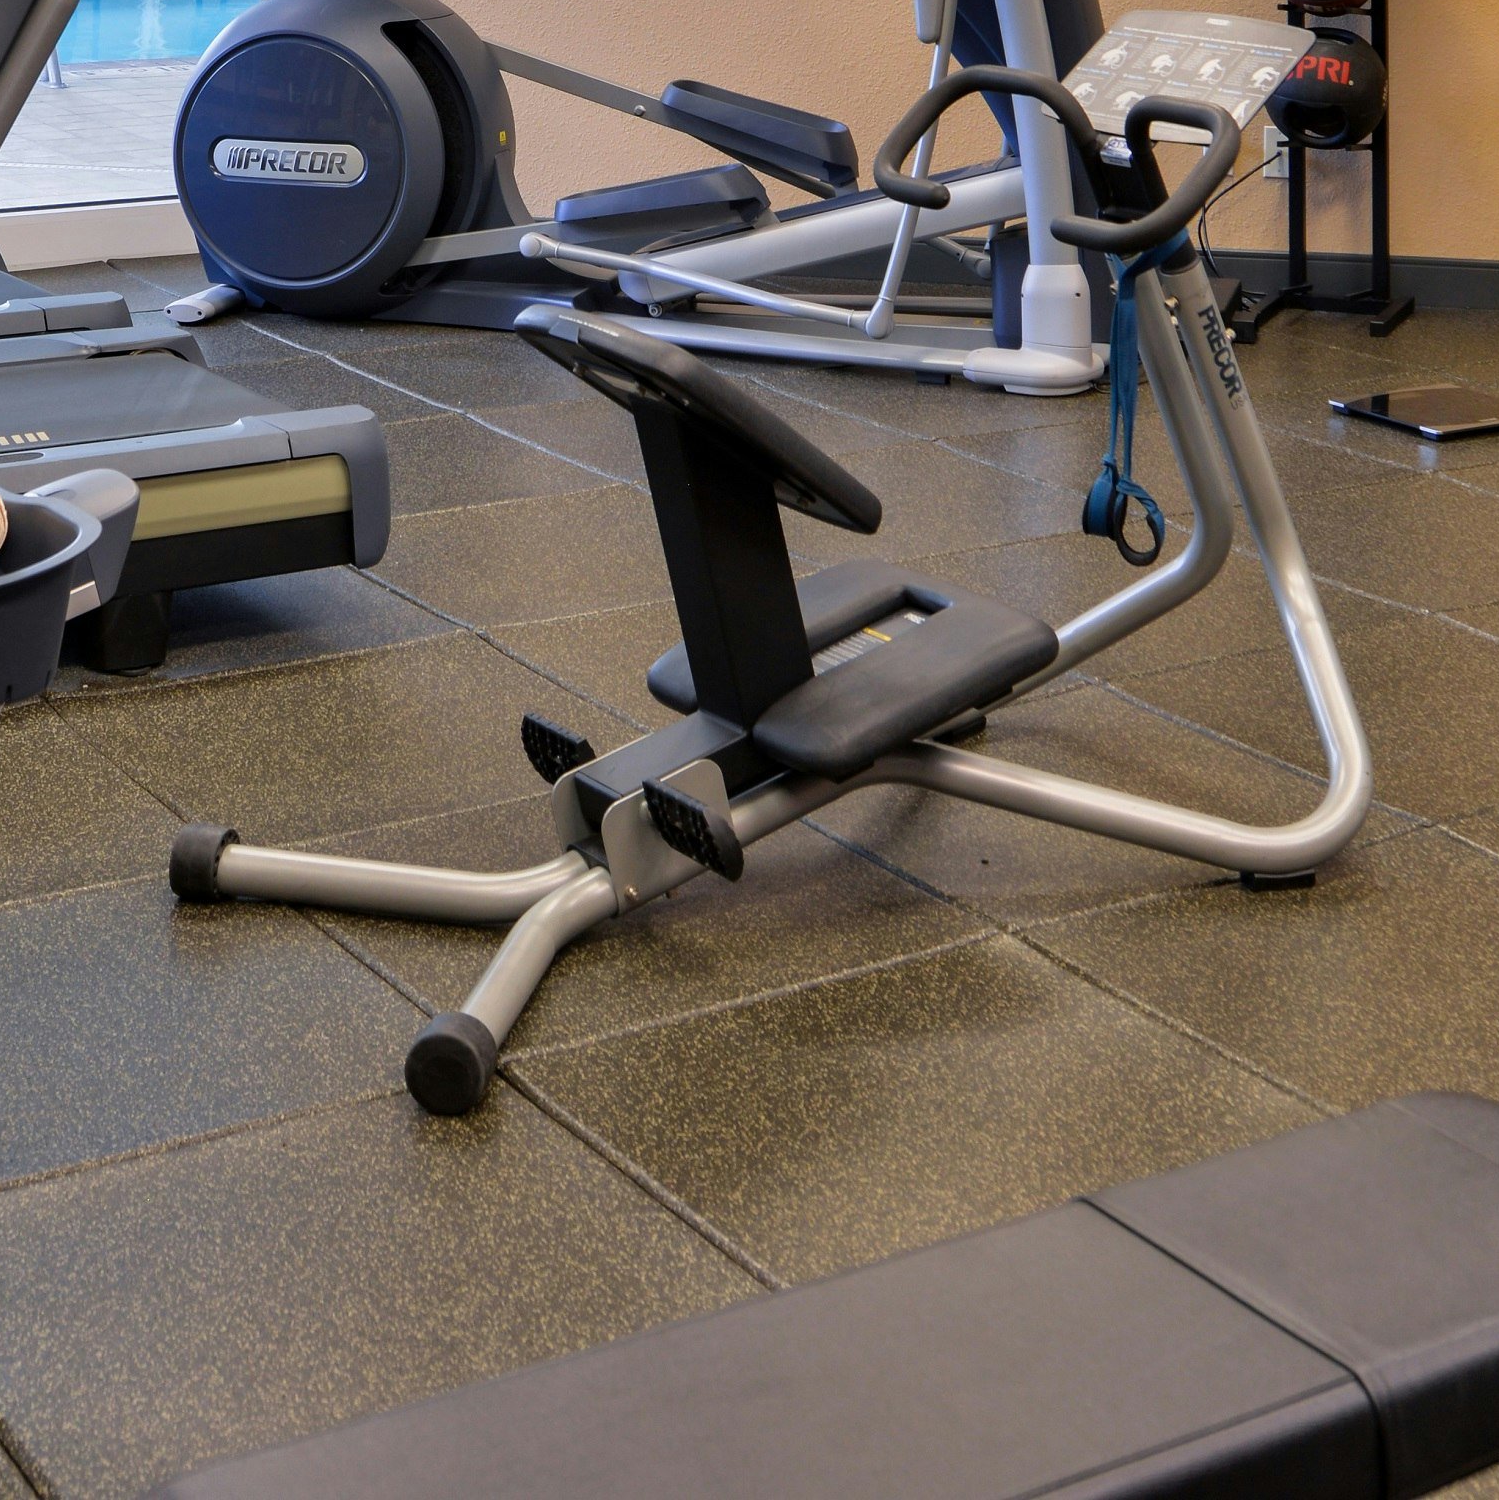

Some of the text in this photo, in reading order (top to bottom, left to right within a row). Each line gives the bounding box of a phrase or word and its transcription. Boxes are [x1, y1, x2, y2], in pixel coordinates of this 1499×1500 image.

[1286, 55, 1350, 85] PRI
[242, 146, 348, 175] PRECOR
[1198, 304, 1242, 399] PRECOR
